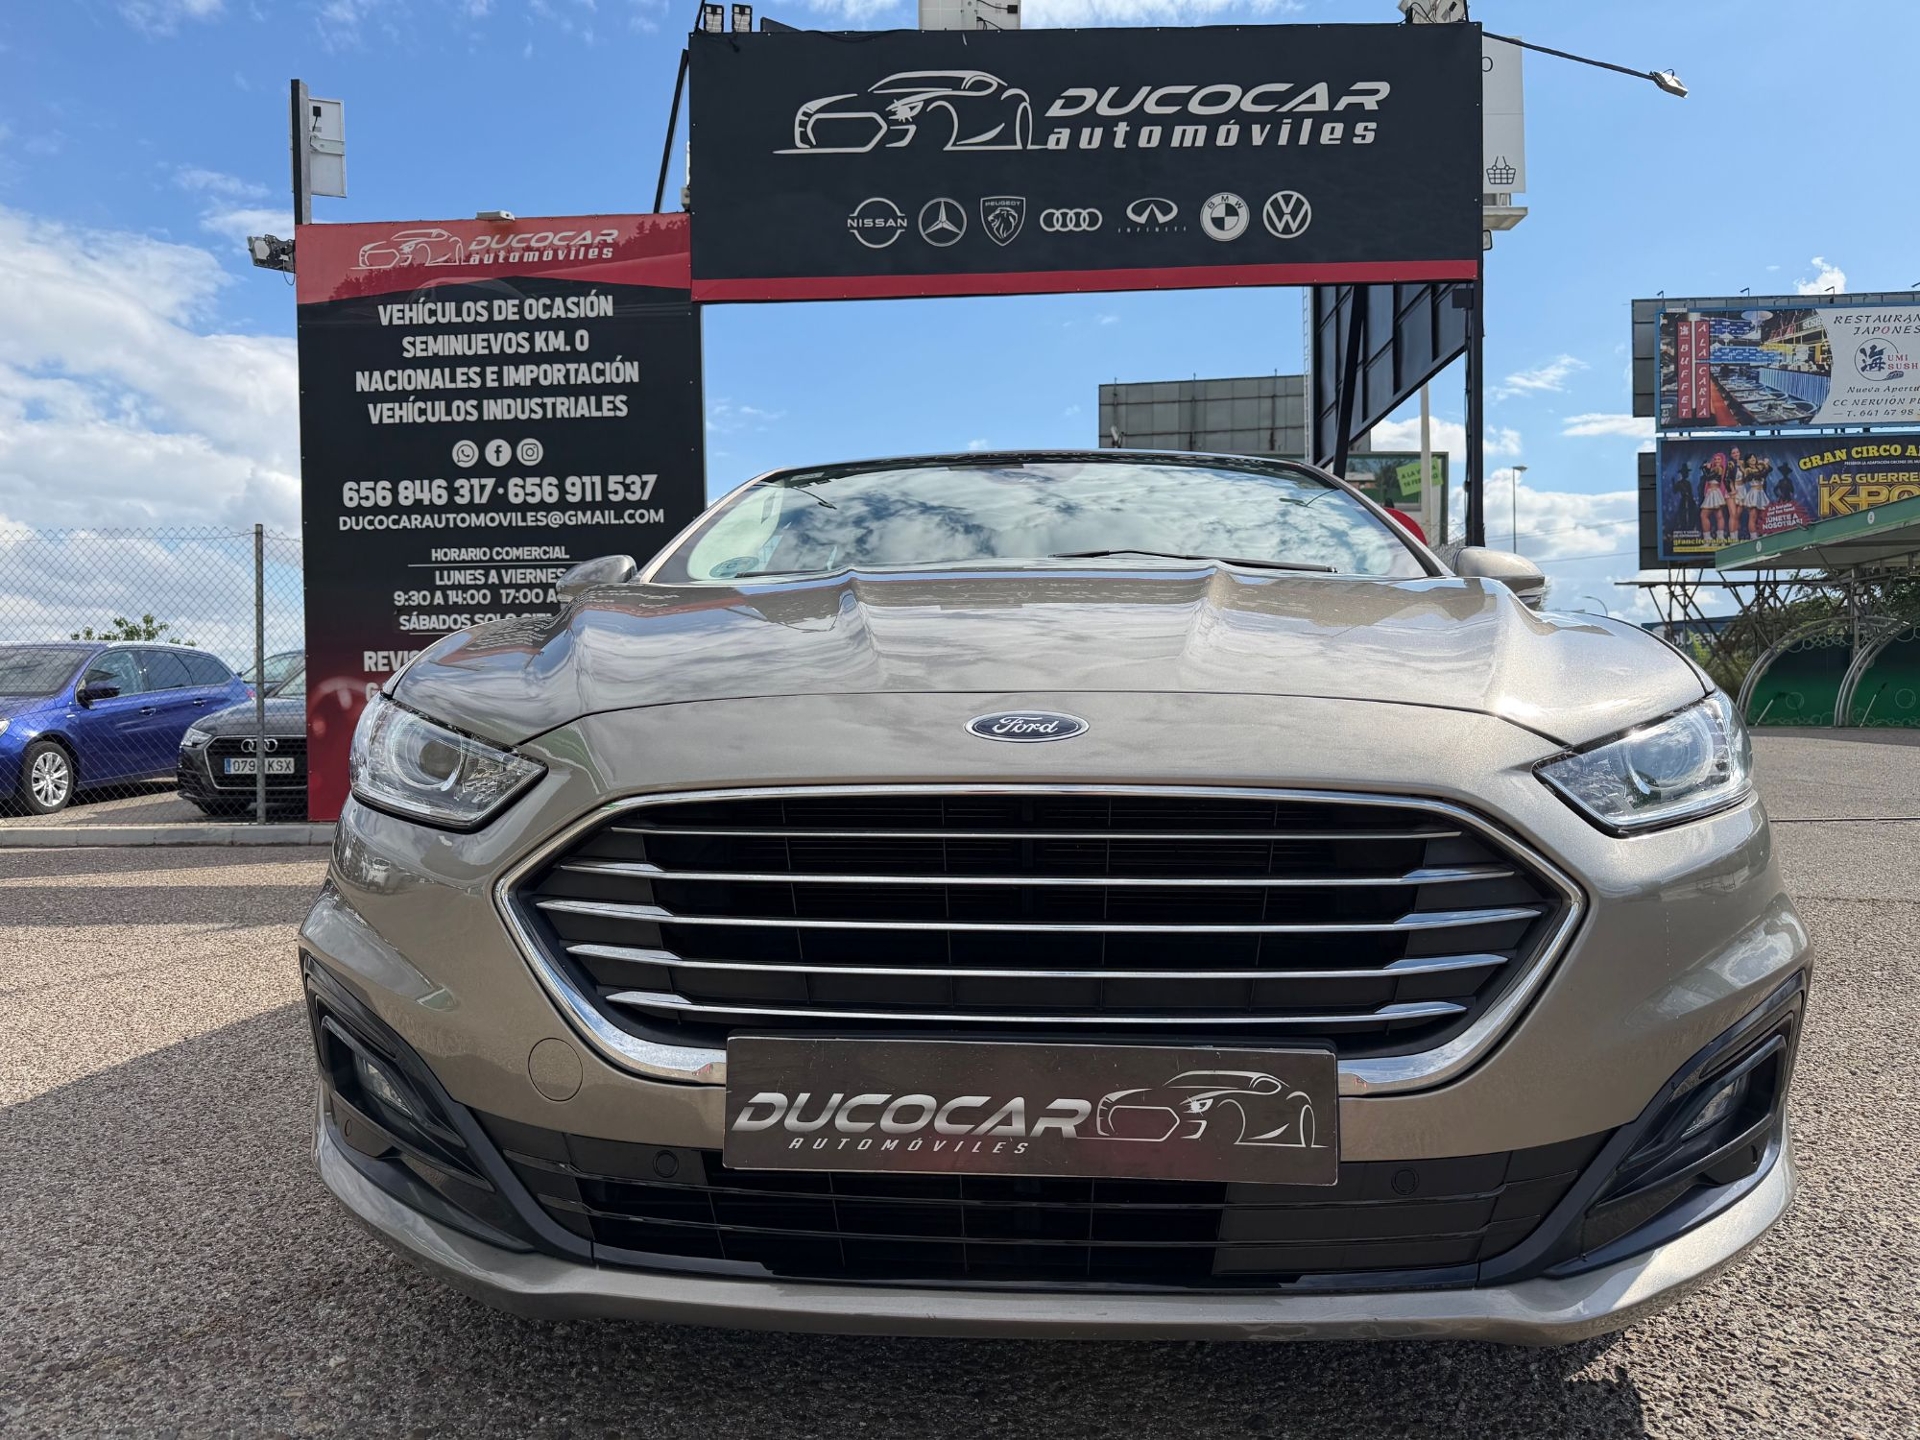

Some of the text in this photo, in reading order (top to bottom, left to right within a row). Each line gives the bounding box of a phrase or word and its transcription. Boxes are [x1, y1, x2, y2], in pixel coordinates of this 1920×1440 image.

[1045, 81, 1391, 117] DUCOCAR
[1047, 118, 1378, 150] automóviles
[1206, 195, 1244, 210] BMW
[847, 218, 908, 228] NISSAN
[468, 229, 619, 250] DUCOCAR
[469, 246, 614, 265] automóviles
[377, 289, 614, 326] VEHÍCULOS DE OCASIÓN
[402, 331, 530, 358] SEMINUEVOS
[534, 330, 571, 352] KM.
[355, 355, 640, 392] NACIONALES E IMPORTACIÓN
[1680, 344, 1690, 417] BUFFET
[1698, 366, 1707, 416] CARTA
[1847, 386, 1880, 394] Nueva
[368, 395, 629, 424] VEHÍCULOS INDUSTRIALES
[1832, 399, 1849, 407] CC
[1852, 394, 1906, 406] NERVIÓN
[1900, 408, 1915, 416] 98
[1798, 444, 1920, 471] GRAN CIRCO A
[1819, 473, 1852, 485] LAS
[342, 480, 393, 508] 656
[398, 478, 448, 506] 846
[565, 475, 602, 503] 911
[607, 474, 658, 502] 537
[339, 508, 665, 531] DUCOCARAUTOMOVILES@GMAIL.COM
[432, 546, 570, 561] HORARIO COMERCIAL
[435, 569, 486, 585] LUNES
[487, 569, 500, 584] A
[393, 588, 558, 606] 9:30 A 14:00 17:00 A
[399, 611, 517, 631] SÁBADOS SO
[991, 716, 1060, 733] Ford
[232, 760, 292, 772] 079 KSX
[731, 1092, 1093, 1139] DUCOCAR
[788, 1135, 1030, 1155] AUTOMÓVILES
